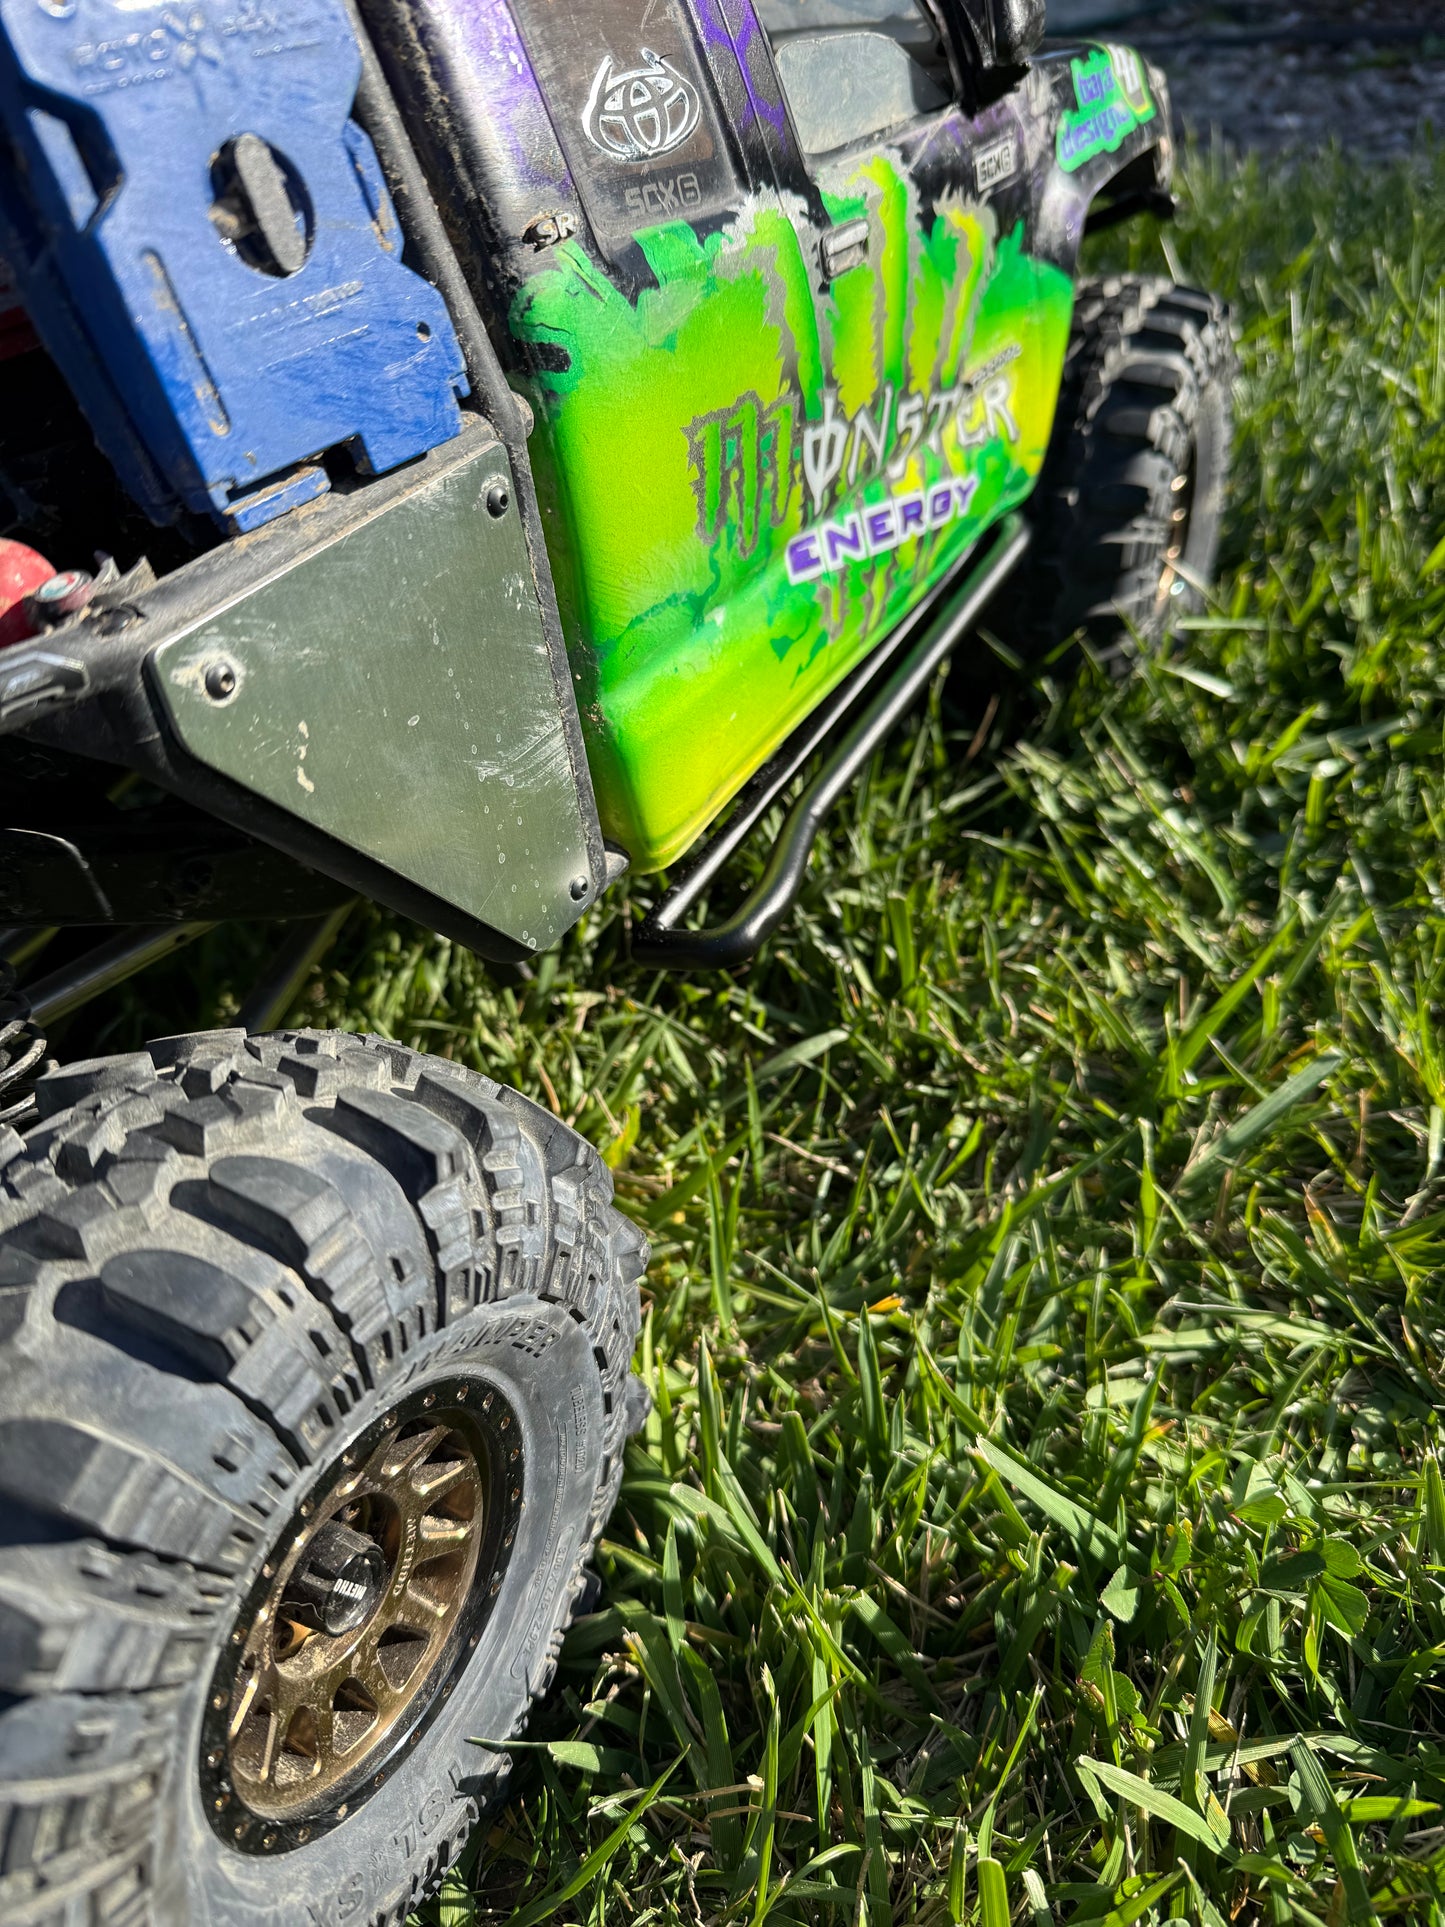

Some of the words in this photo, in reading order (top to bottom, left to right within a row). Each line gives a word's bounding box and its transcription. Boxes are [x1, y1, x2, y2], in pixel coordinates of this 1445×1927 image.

[624, 172, 702, 217] SCX6
[786, 474, 979, 586] ENERGY
[569, 1384, 589, 1437] TUBELESS
[394, 1518, 418, 1596] METHOD
